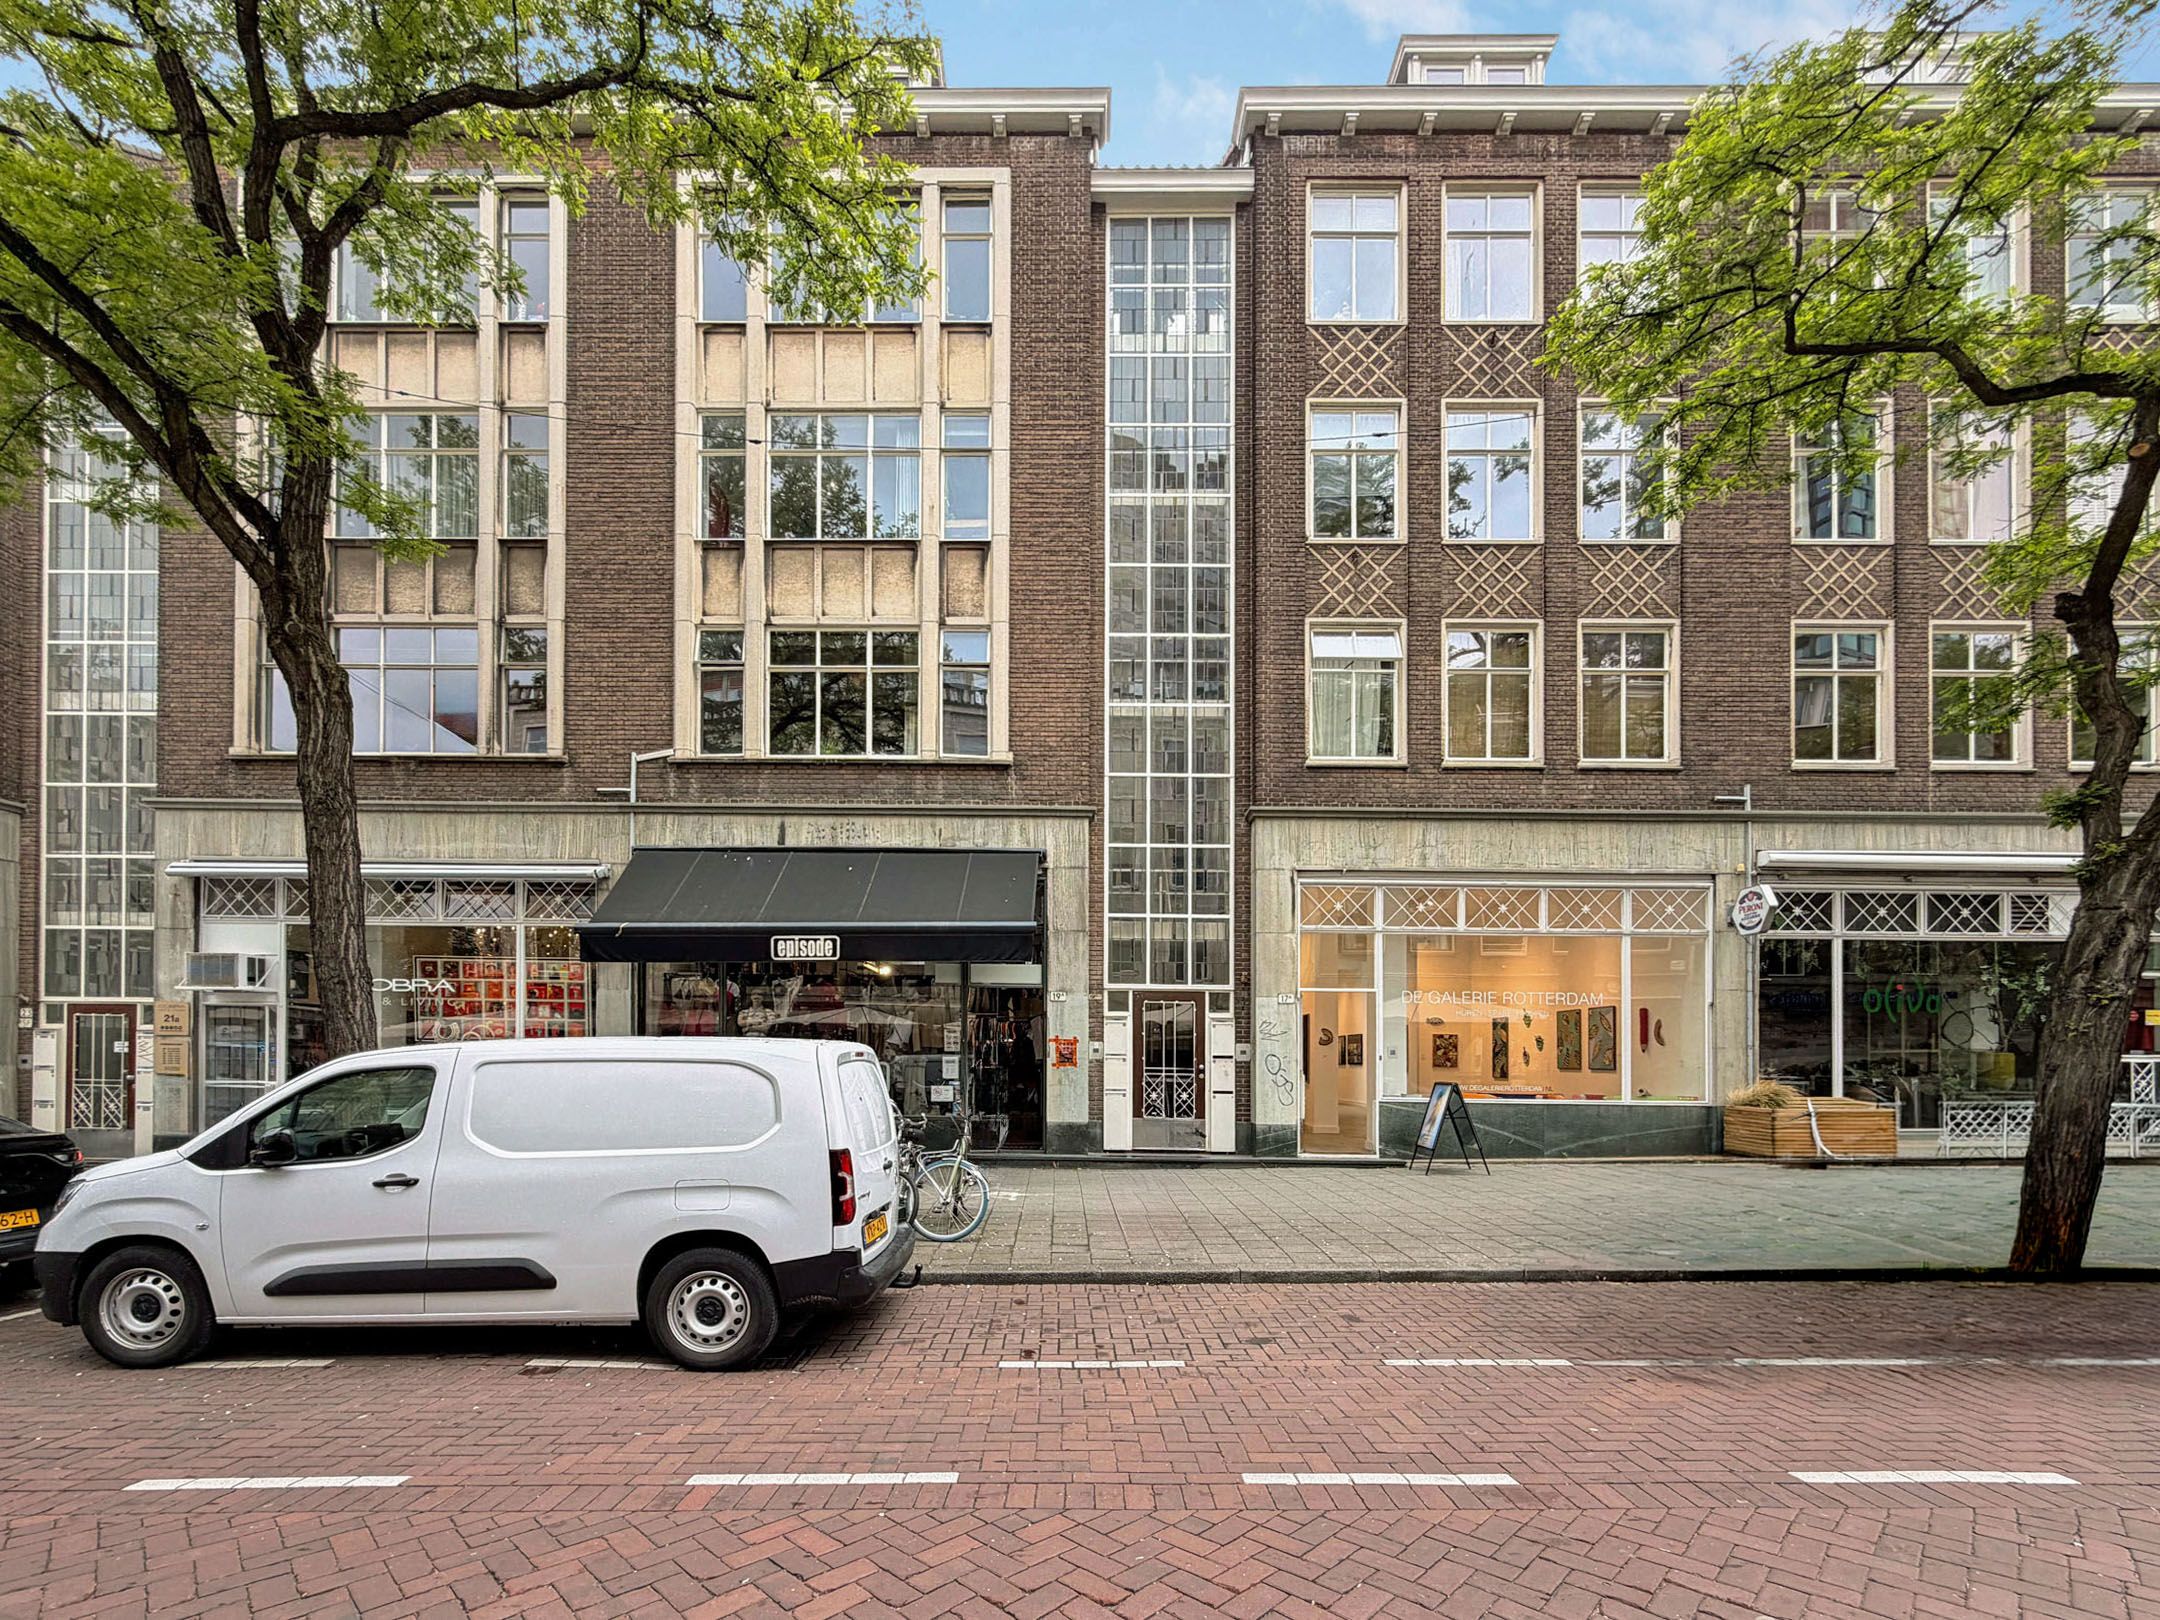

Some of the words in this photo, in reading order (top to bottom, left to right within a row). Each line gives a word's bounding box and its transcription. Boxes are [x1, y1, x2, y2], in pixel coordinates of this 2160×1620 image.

[777, 937, 833, 958] episode
[382, 997, 392, 1006] &
[1401, 990, 1424, 1004] DE
[1428, 990, 1498, 1004] GALERIE
[1502, 991, 1604, 1006] ROTTERDAM
